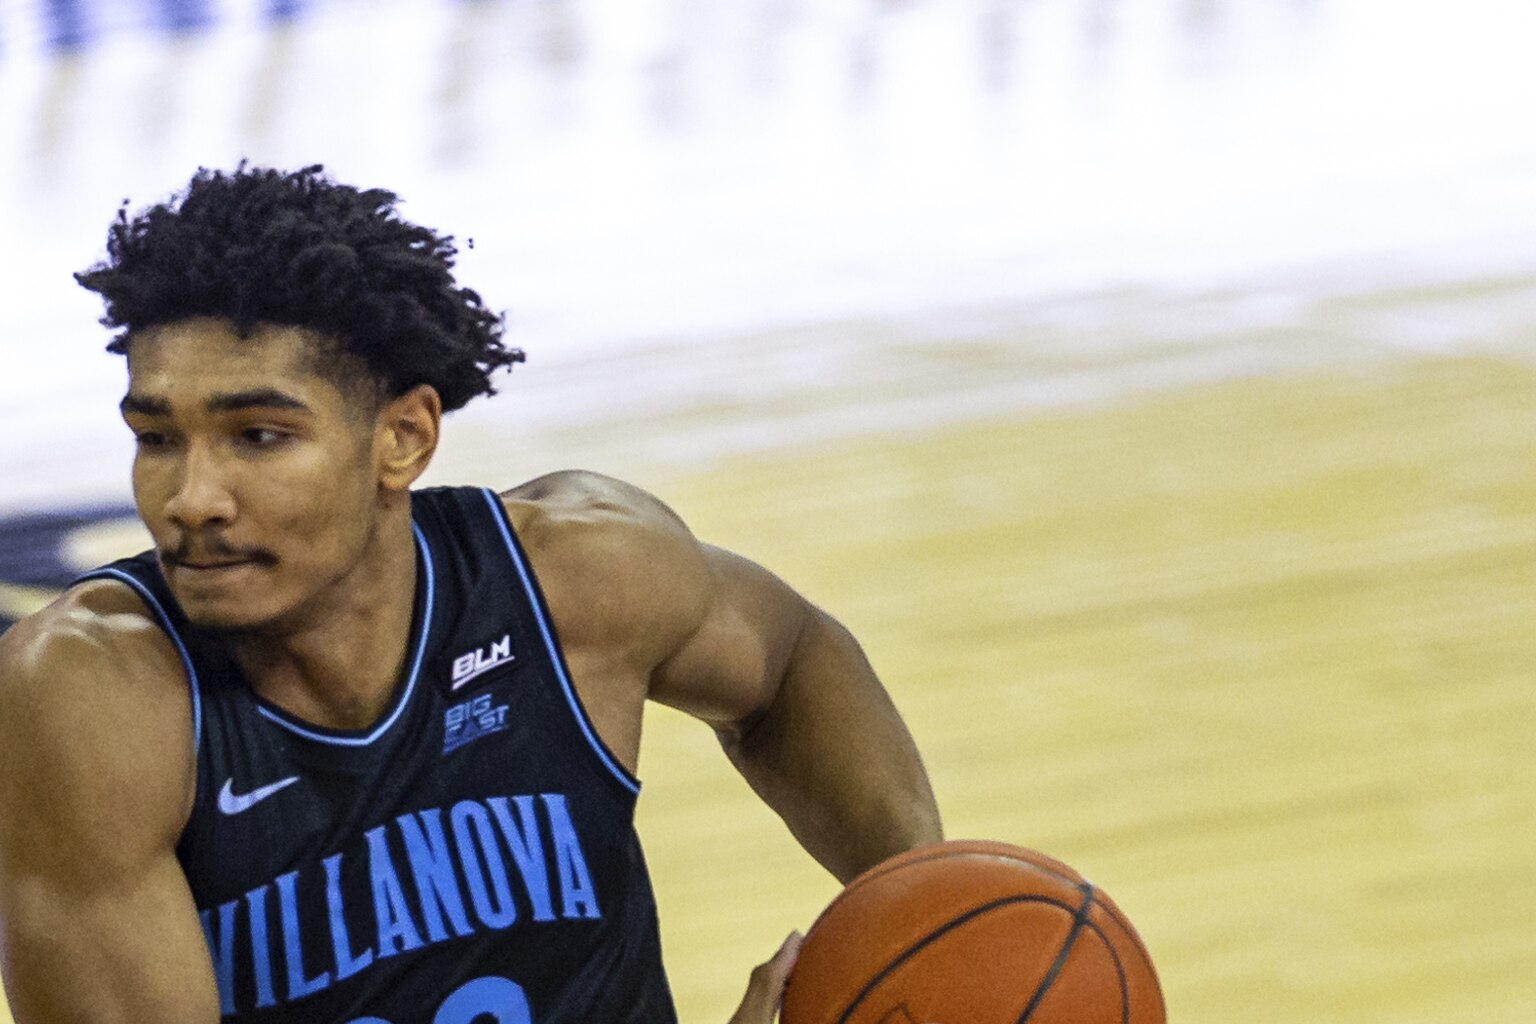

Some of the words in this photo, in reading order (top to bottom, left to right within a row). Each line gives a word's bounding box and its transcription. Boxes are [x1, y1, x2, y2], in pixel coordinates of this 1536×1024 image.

[452, 634, 511, 680] BLM
[445, 694, 492, 725] BIG
[201, 793, 601, 1016] VILLANOVA
